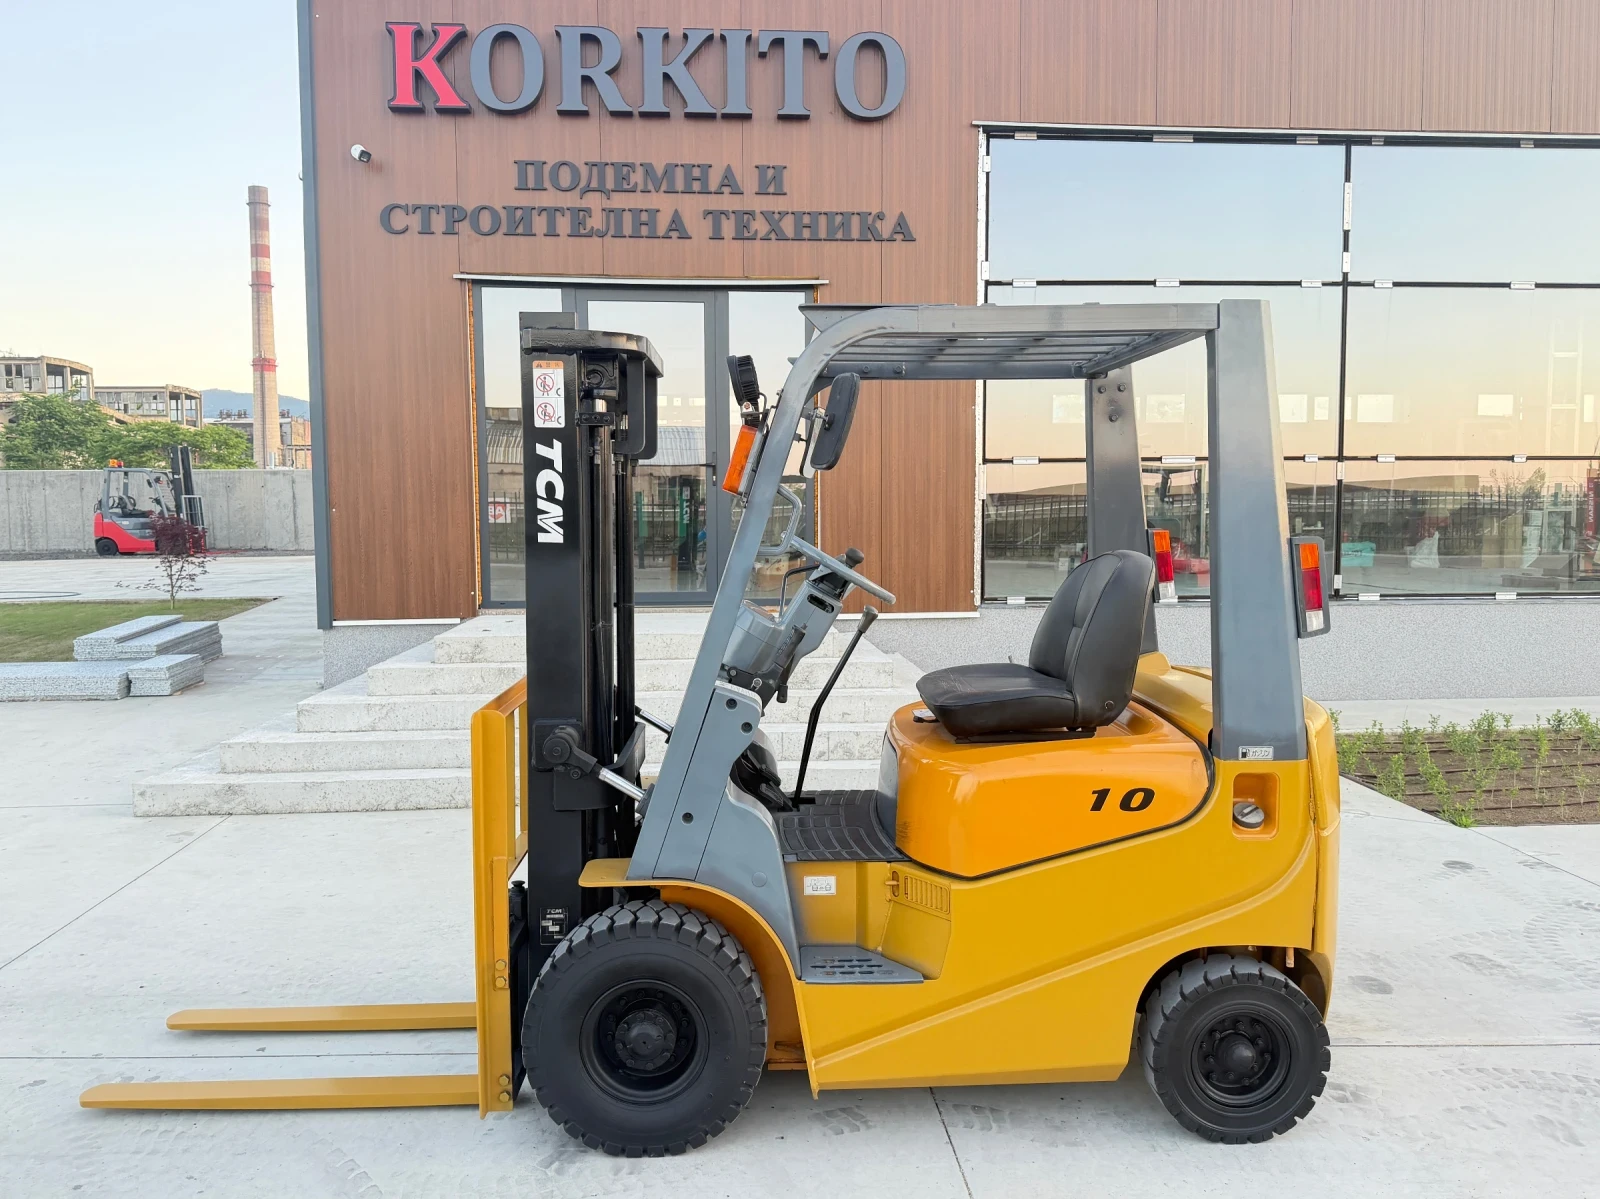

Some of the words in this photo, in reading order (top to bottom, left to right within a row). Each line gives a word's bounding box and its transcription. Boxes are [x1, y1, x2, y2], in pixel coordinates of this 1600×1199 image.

[385, 21, 908, 121] KORKITO
[513, 159, 744, 198] ПОДЕМНА
[755, 164, 787, 196] И
[380, 203, 692, 240] СТРОИТЕЛНА
[703, 208, 916, 242] ТЕХНИКА
[536, 438, 564, 543] TCM
[1090, 787, 1155, 812] 10
